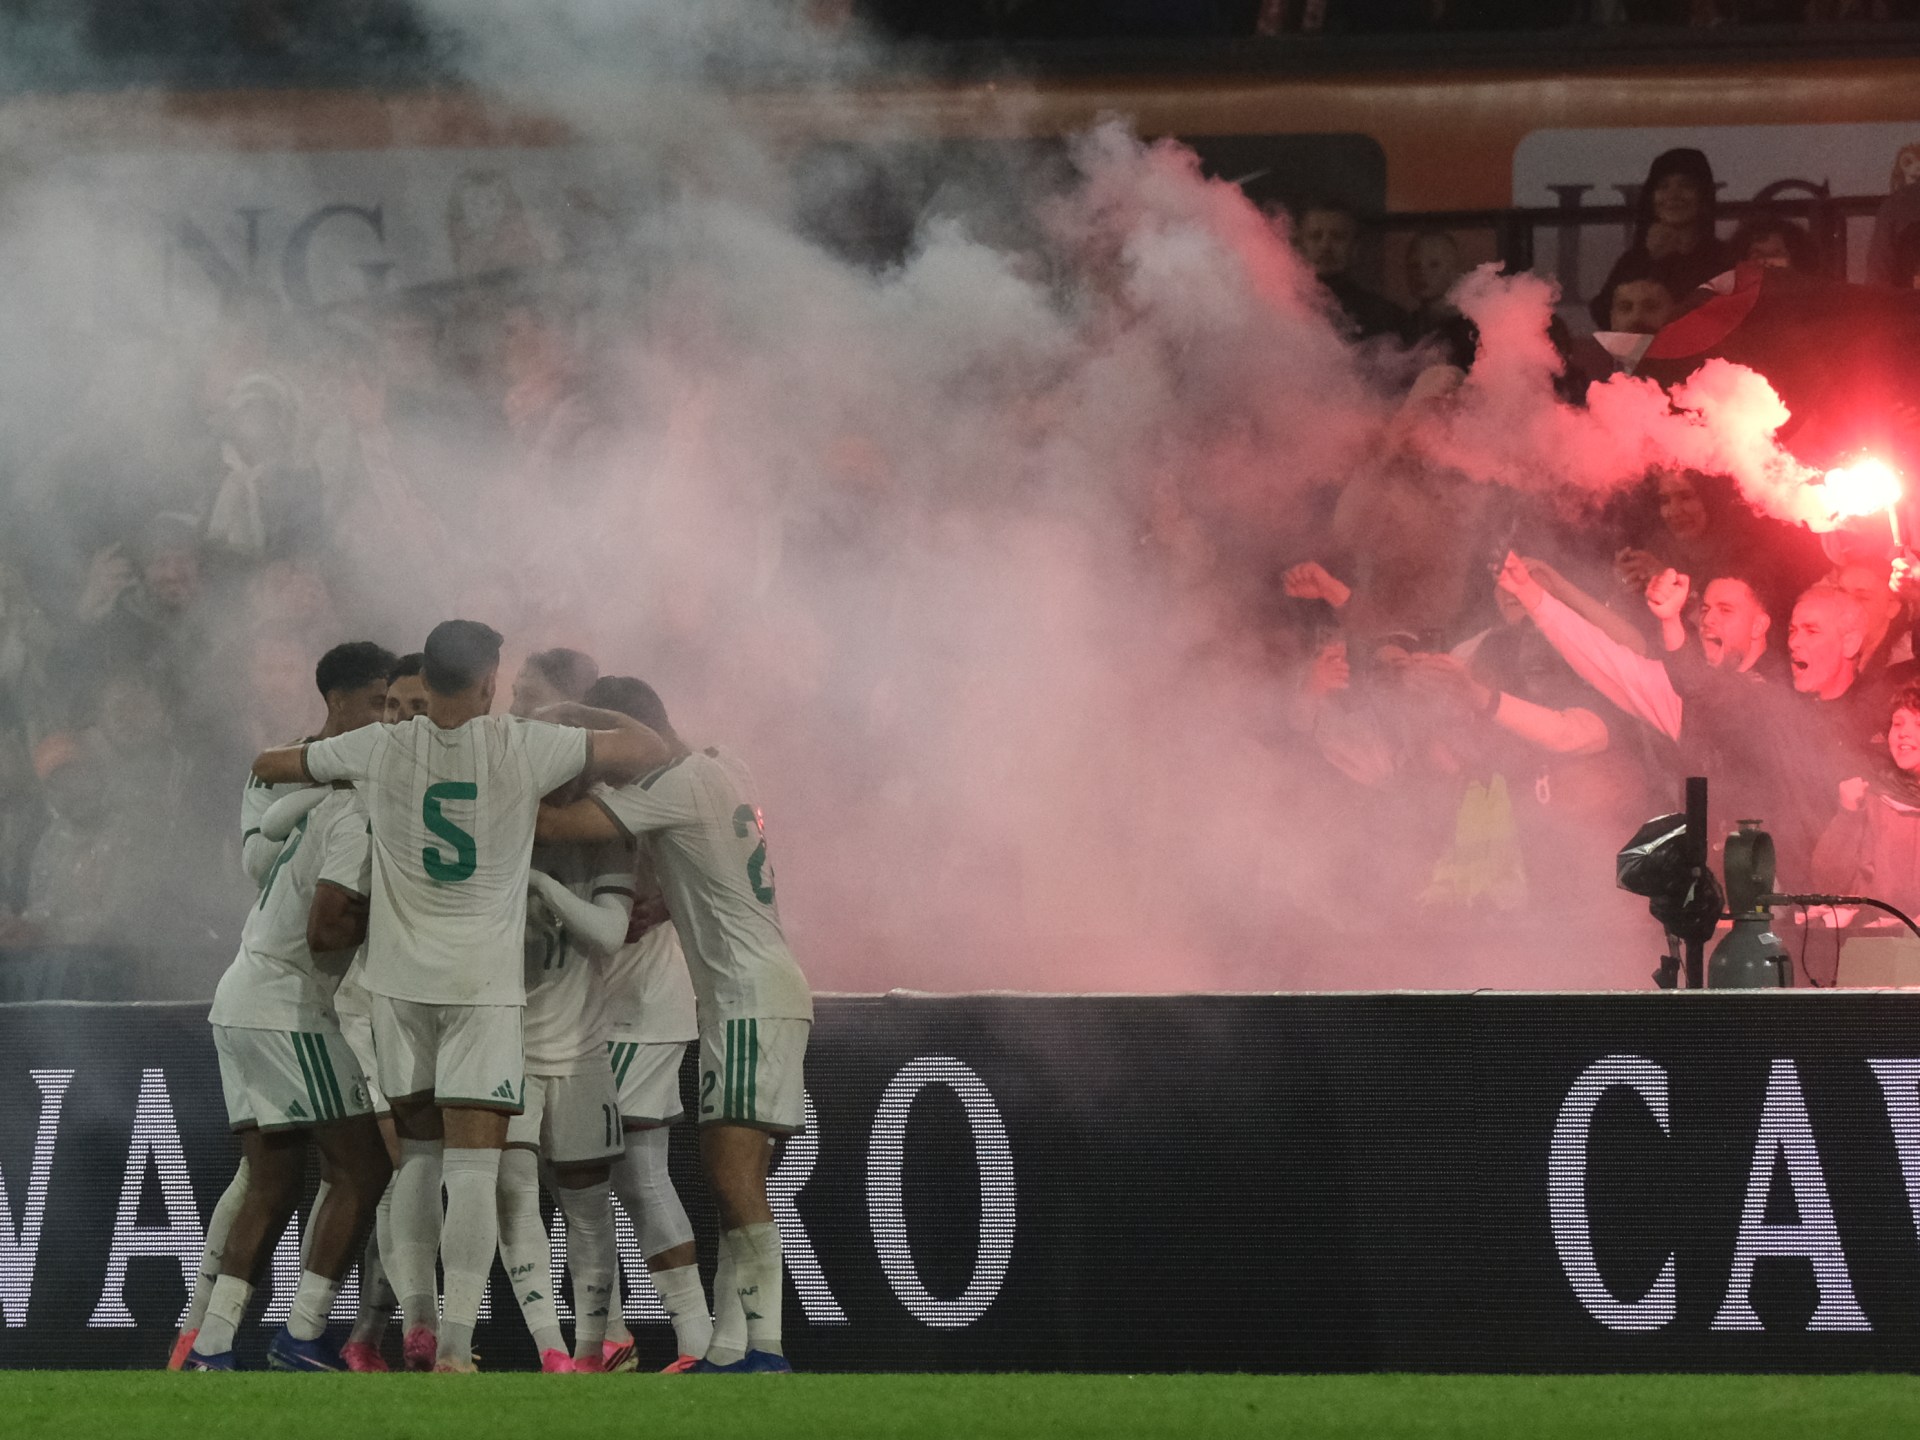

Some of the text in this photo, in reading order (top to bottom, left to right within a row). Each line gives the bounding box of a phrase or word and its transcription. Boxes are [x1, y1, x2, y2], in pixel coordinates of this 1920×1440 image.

[422, 781, 478, 882] 5
[701, 1070, 717, 1114] 2
[602, 1102, 622, 1147] 11
[510, 1262, 536, 1279] FAF
